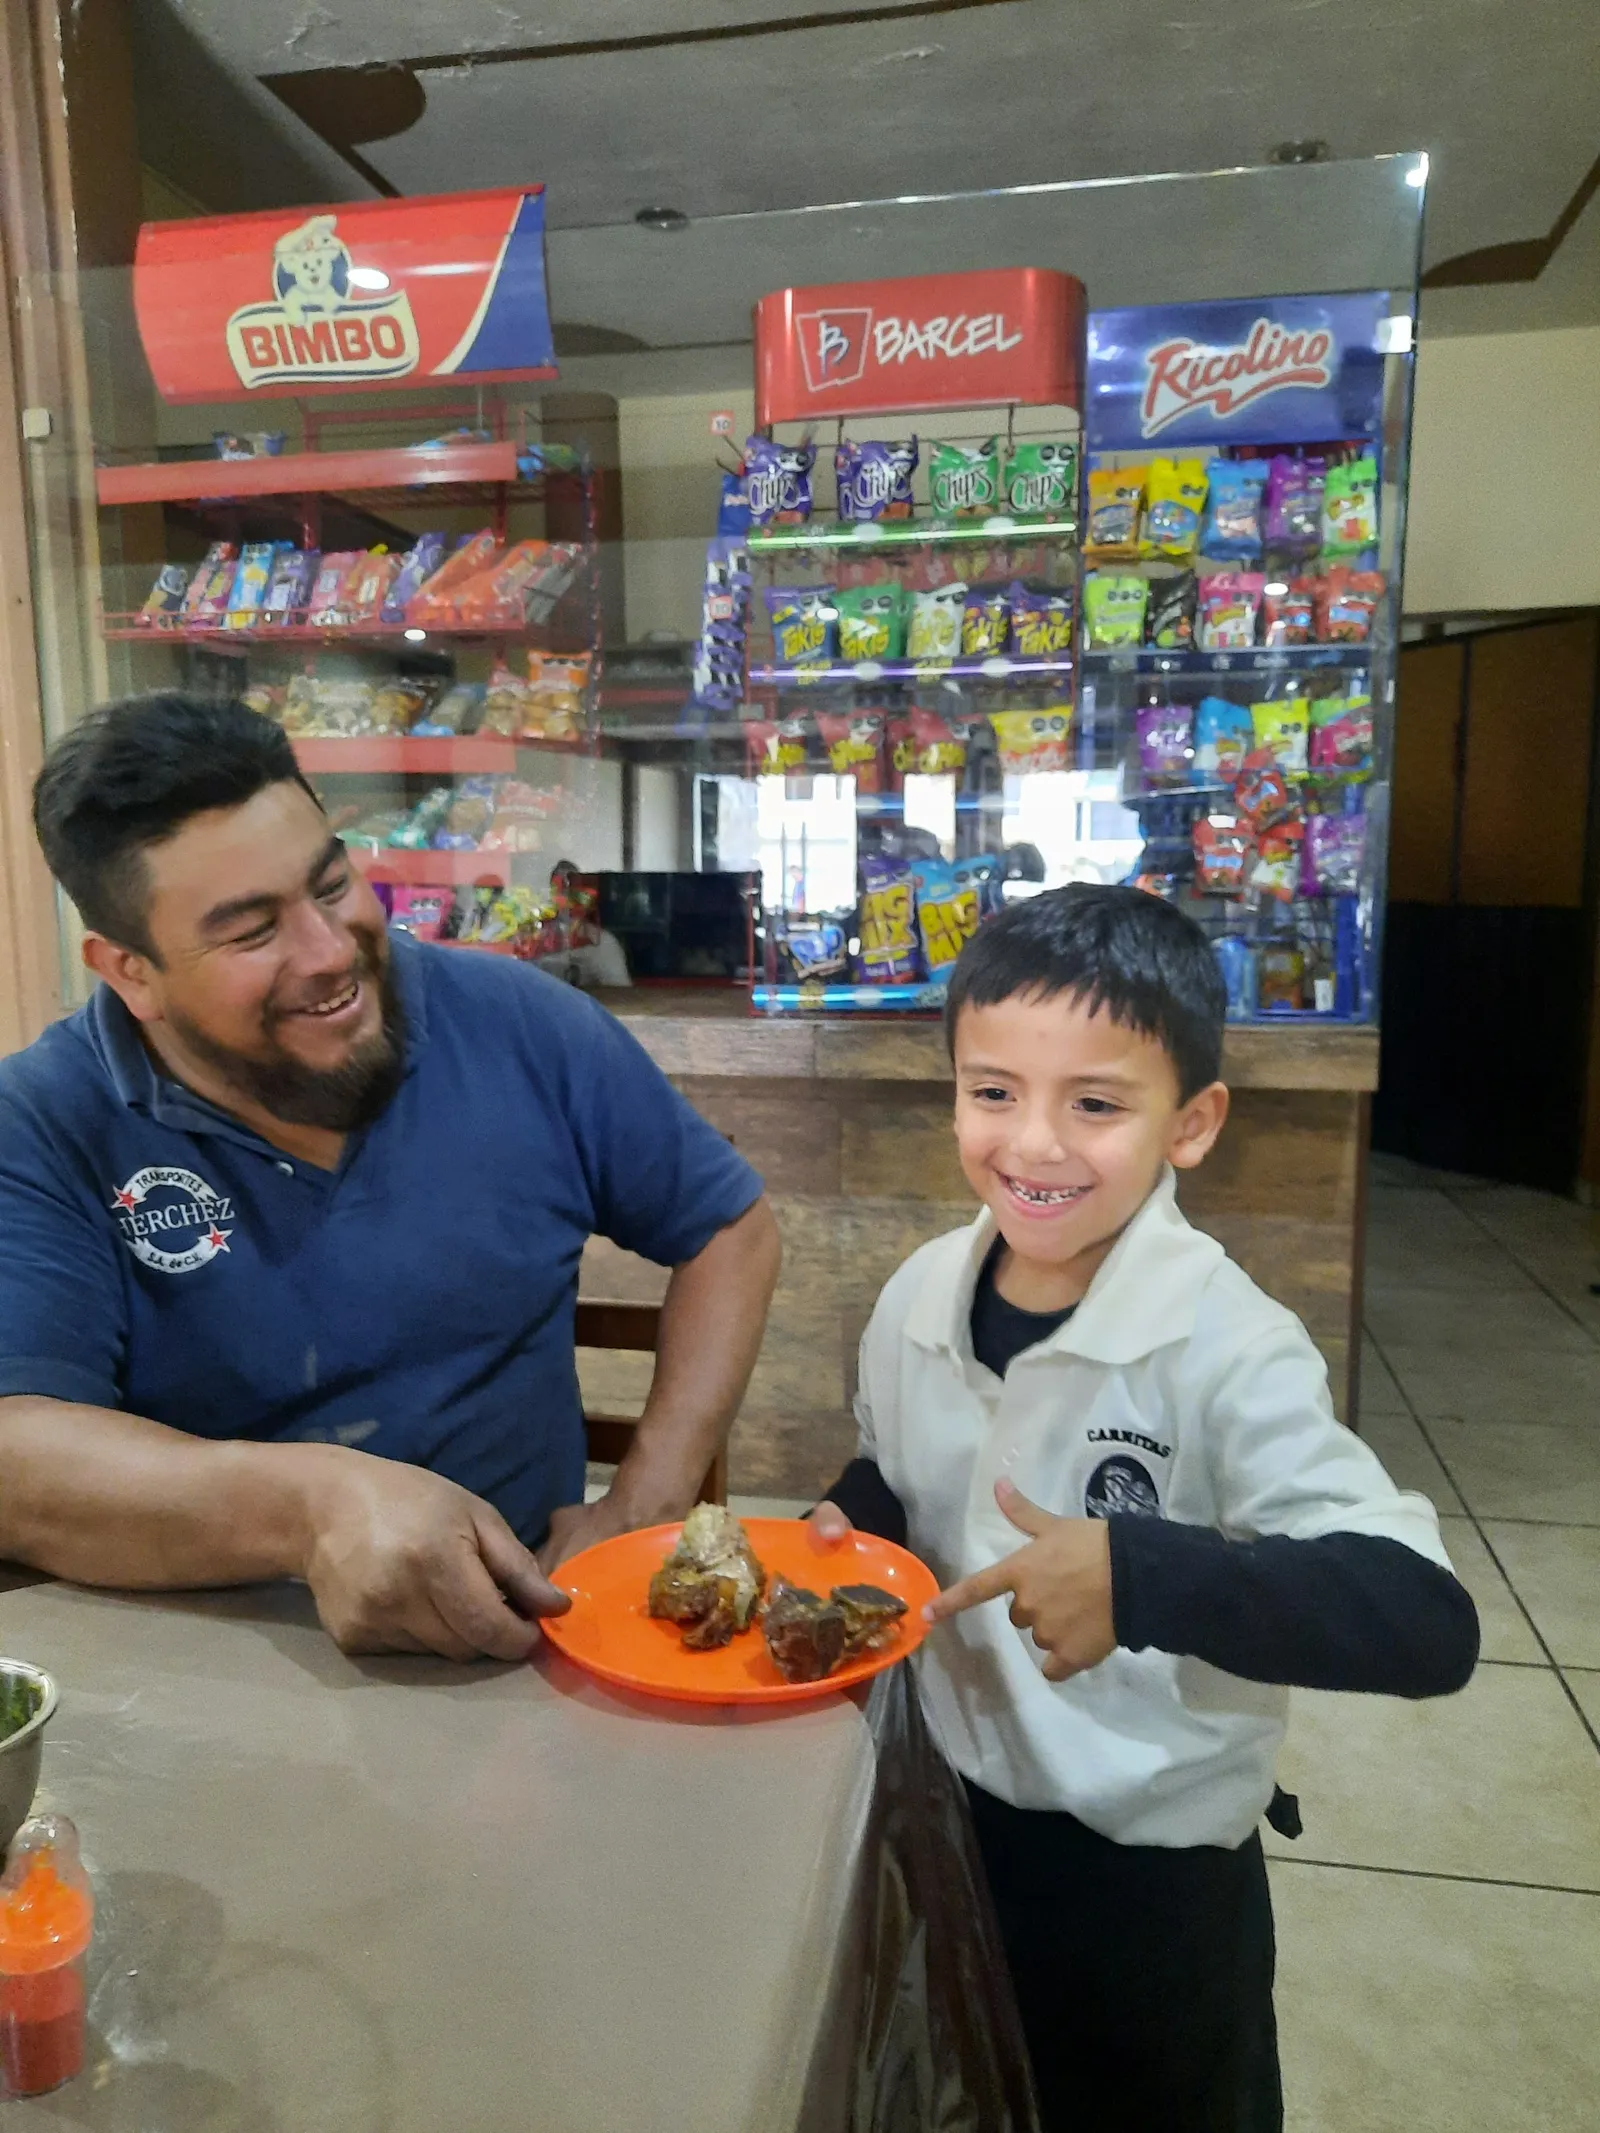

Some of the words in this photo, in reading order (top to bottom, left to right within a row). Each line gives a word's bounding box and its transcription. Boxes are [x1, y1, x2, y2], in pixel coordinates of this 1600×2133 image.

[239, 314, 406, 369] BIMBO
[873, 314, 1023, 366] BARCEL
[1144, 321, 1331, 420] Ricolino
[135, 1171, 203, 1193] TRANSPORTES
